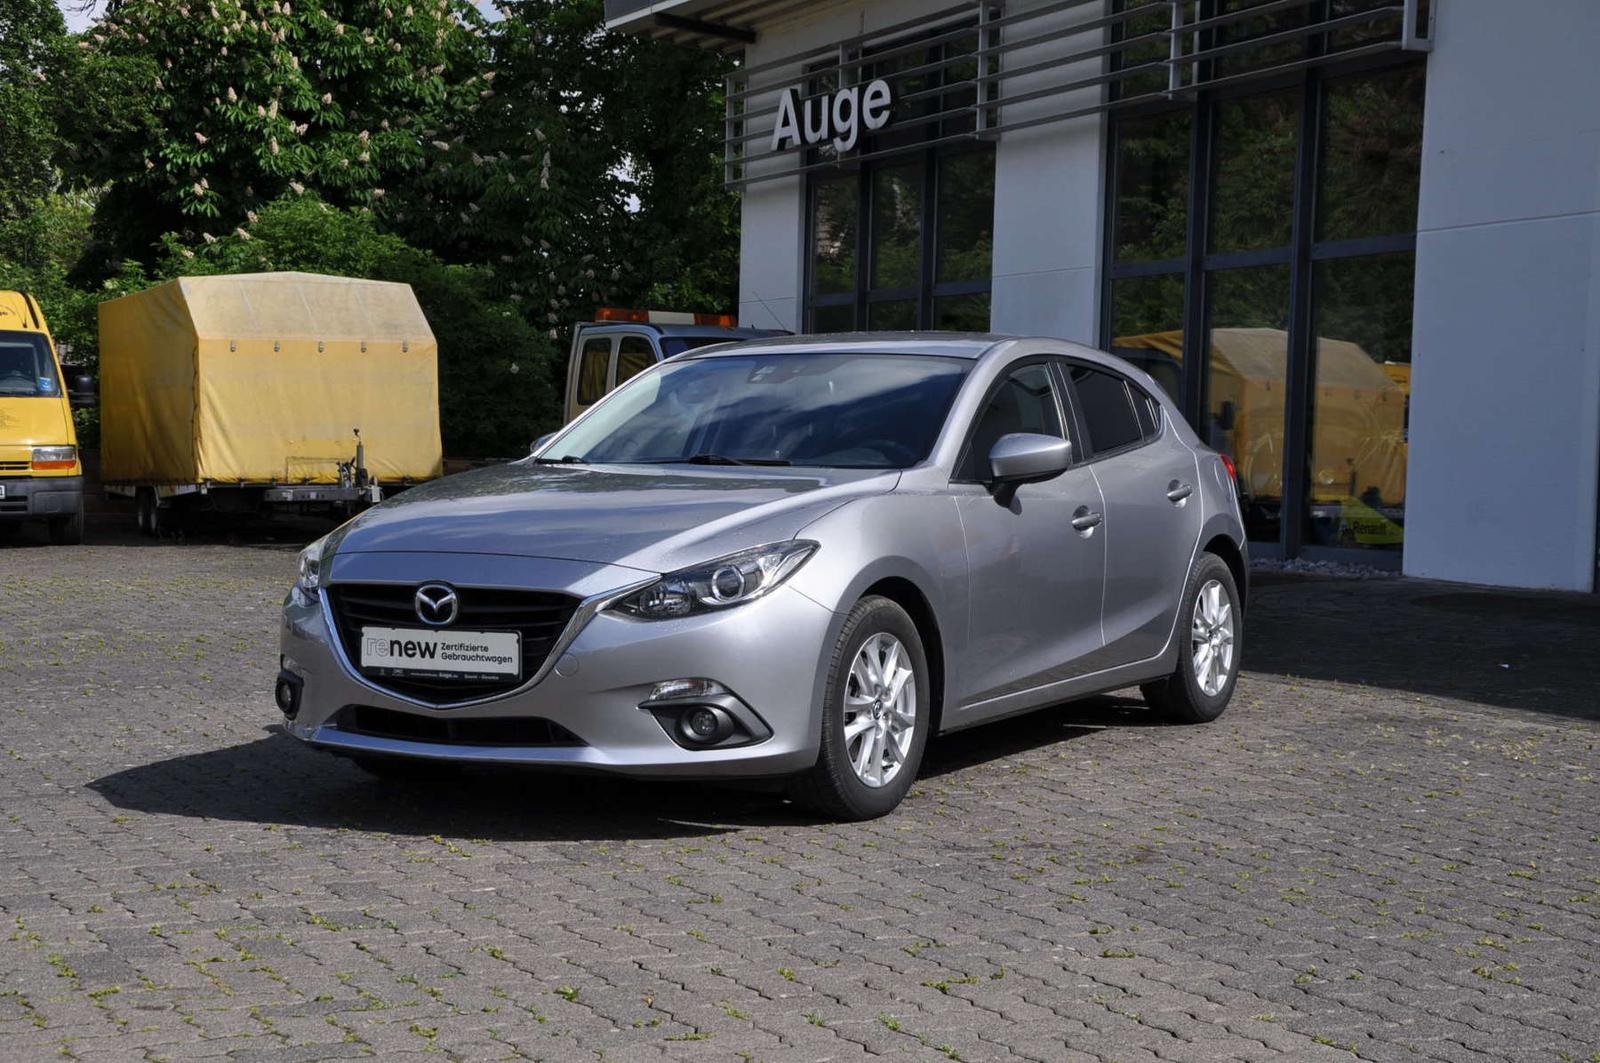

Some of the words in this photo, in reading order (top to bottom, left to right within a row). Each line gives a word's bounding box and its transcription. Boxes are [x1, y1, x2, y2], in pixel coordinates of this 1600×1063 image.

[770, 79, 892, 153] Auge
[366, 637, 438, 659] renew
[441, 642, 489, 653] Zertifizierte
[441, 652, 513, 665] Gebrauchtwagen
